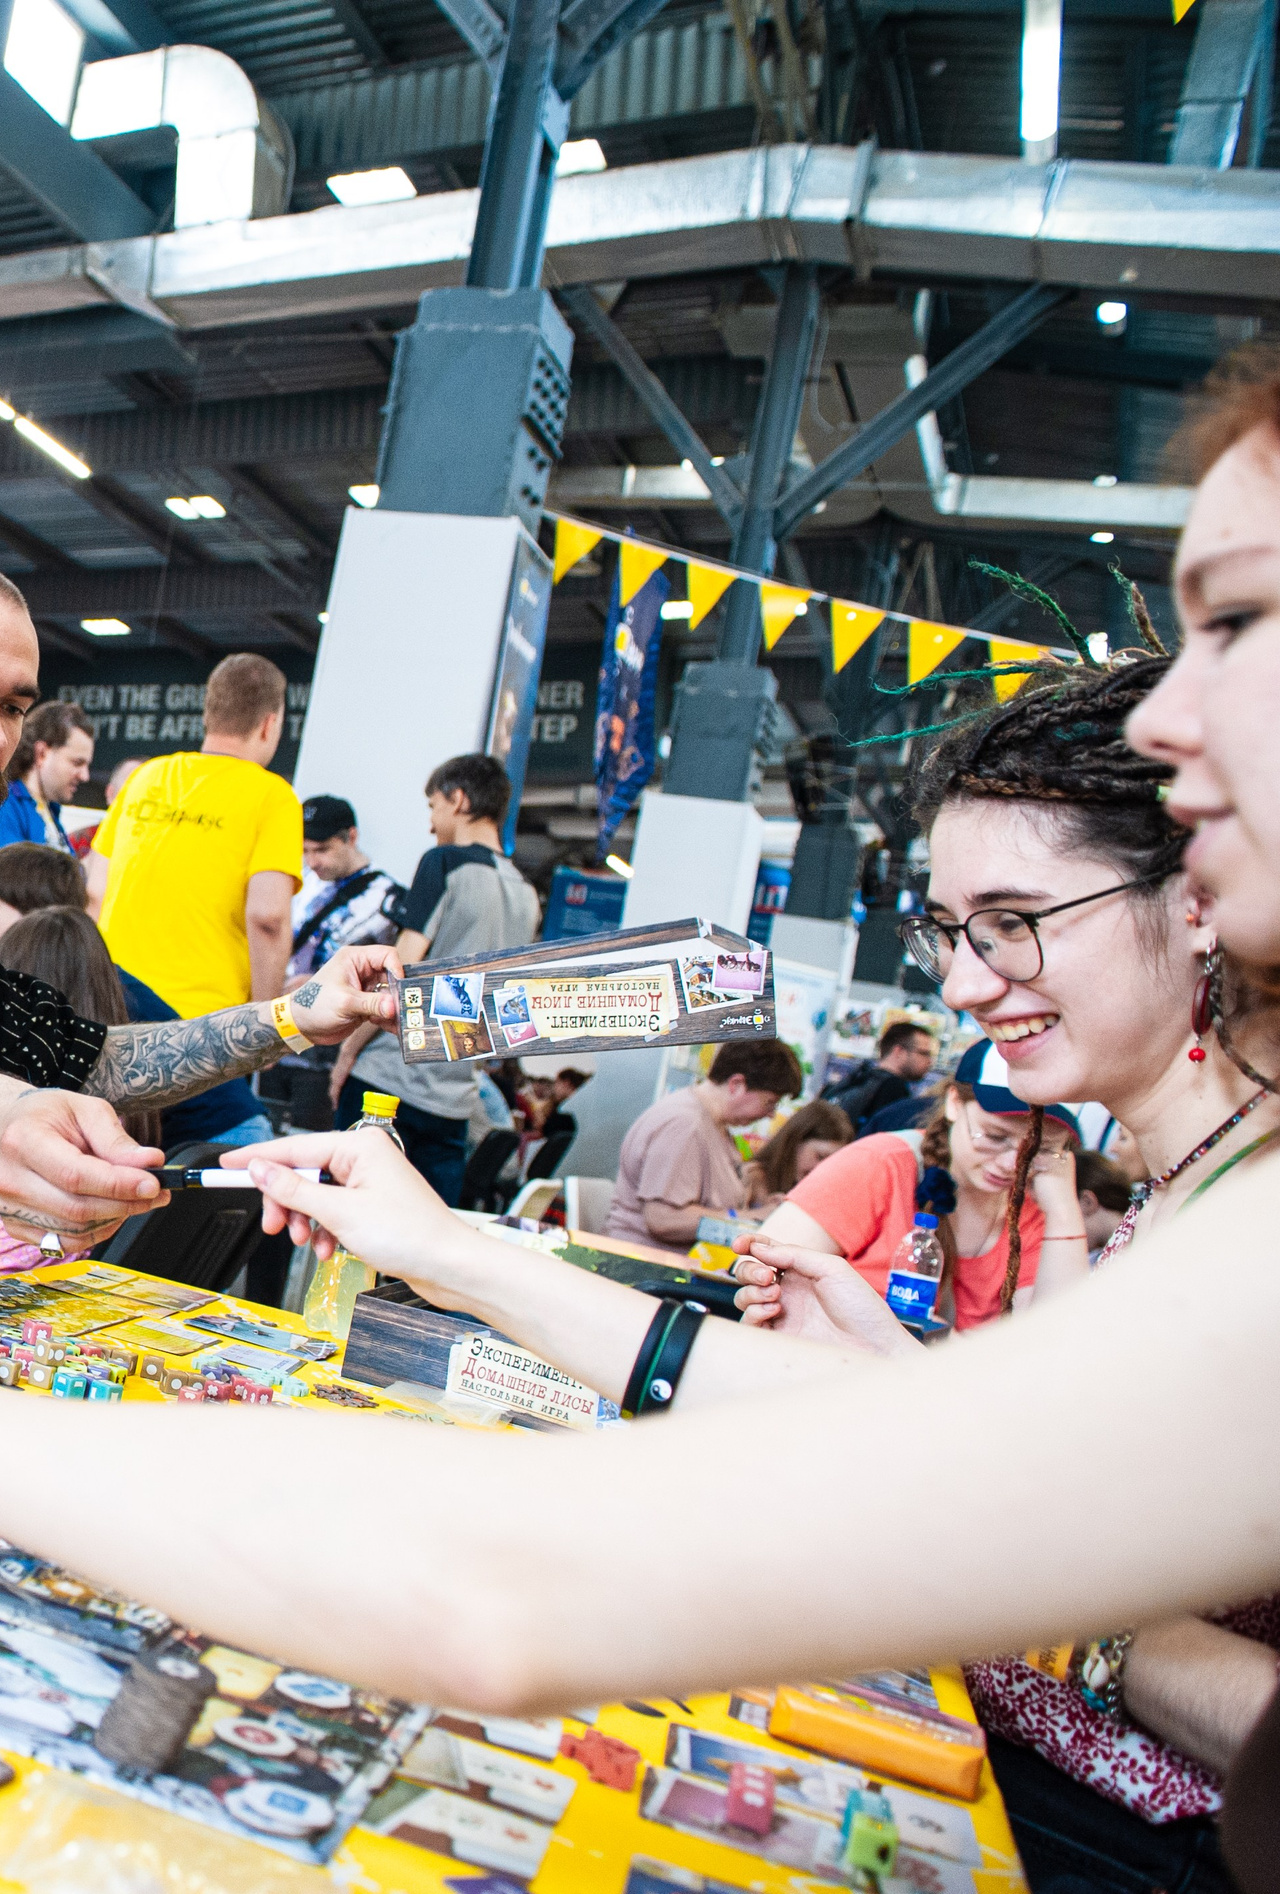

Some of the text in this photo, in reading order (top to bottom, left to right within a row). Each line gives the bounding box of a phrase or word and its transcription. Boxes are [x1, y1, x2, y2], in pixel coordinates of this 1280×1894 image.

[119, 684, 160, 710] THE
[125, 714, 157, 741] BE
[550, 982, 660, 992] НАСТОЛЬНАЯ ИГРА
[531, 992, 662, 1012] ДОМАШНИЕ ЛИСЫ
[891, 1285, 920, 1303] ВОДА
[461, 1356, 595, 1415] ДОМАШНИЕ ЛИСЫ
[460, 1378, 570, 1420] НАСТОЛЬНАЯ ИГРА
